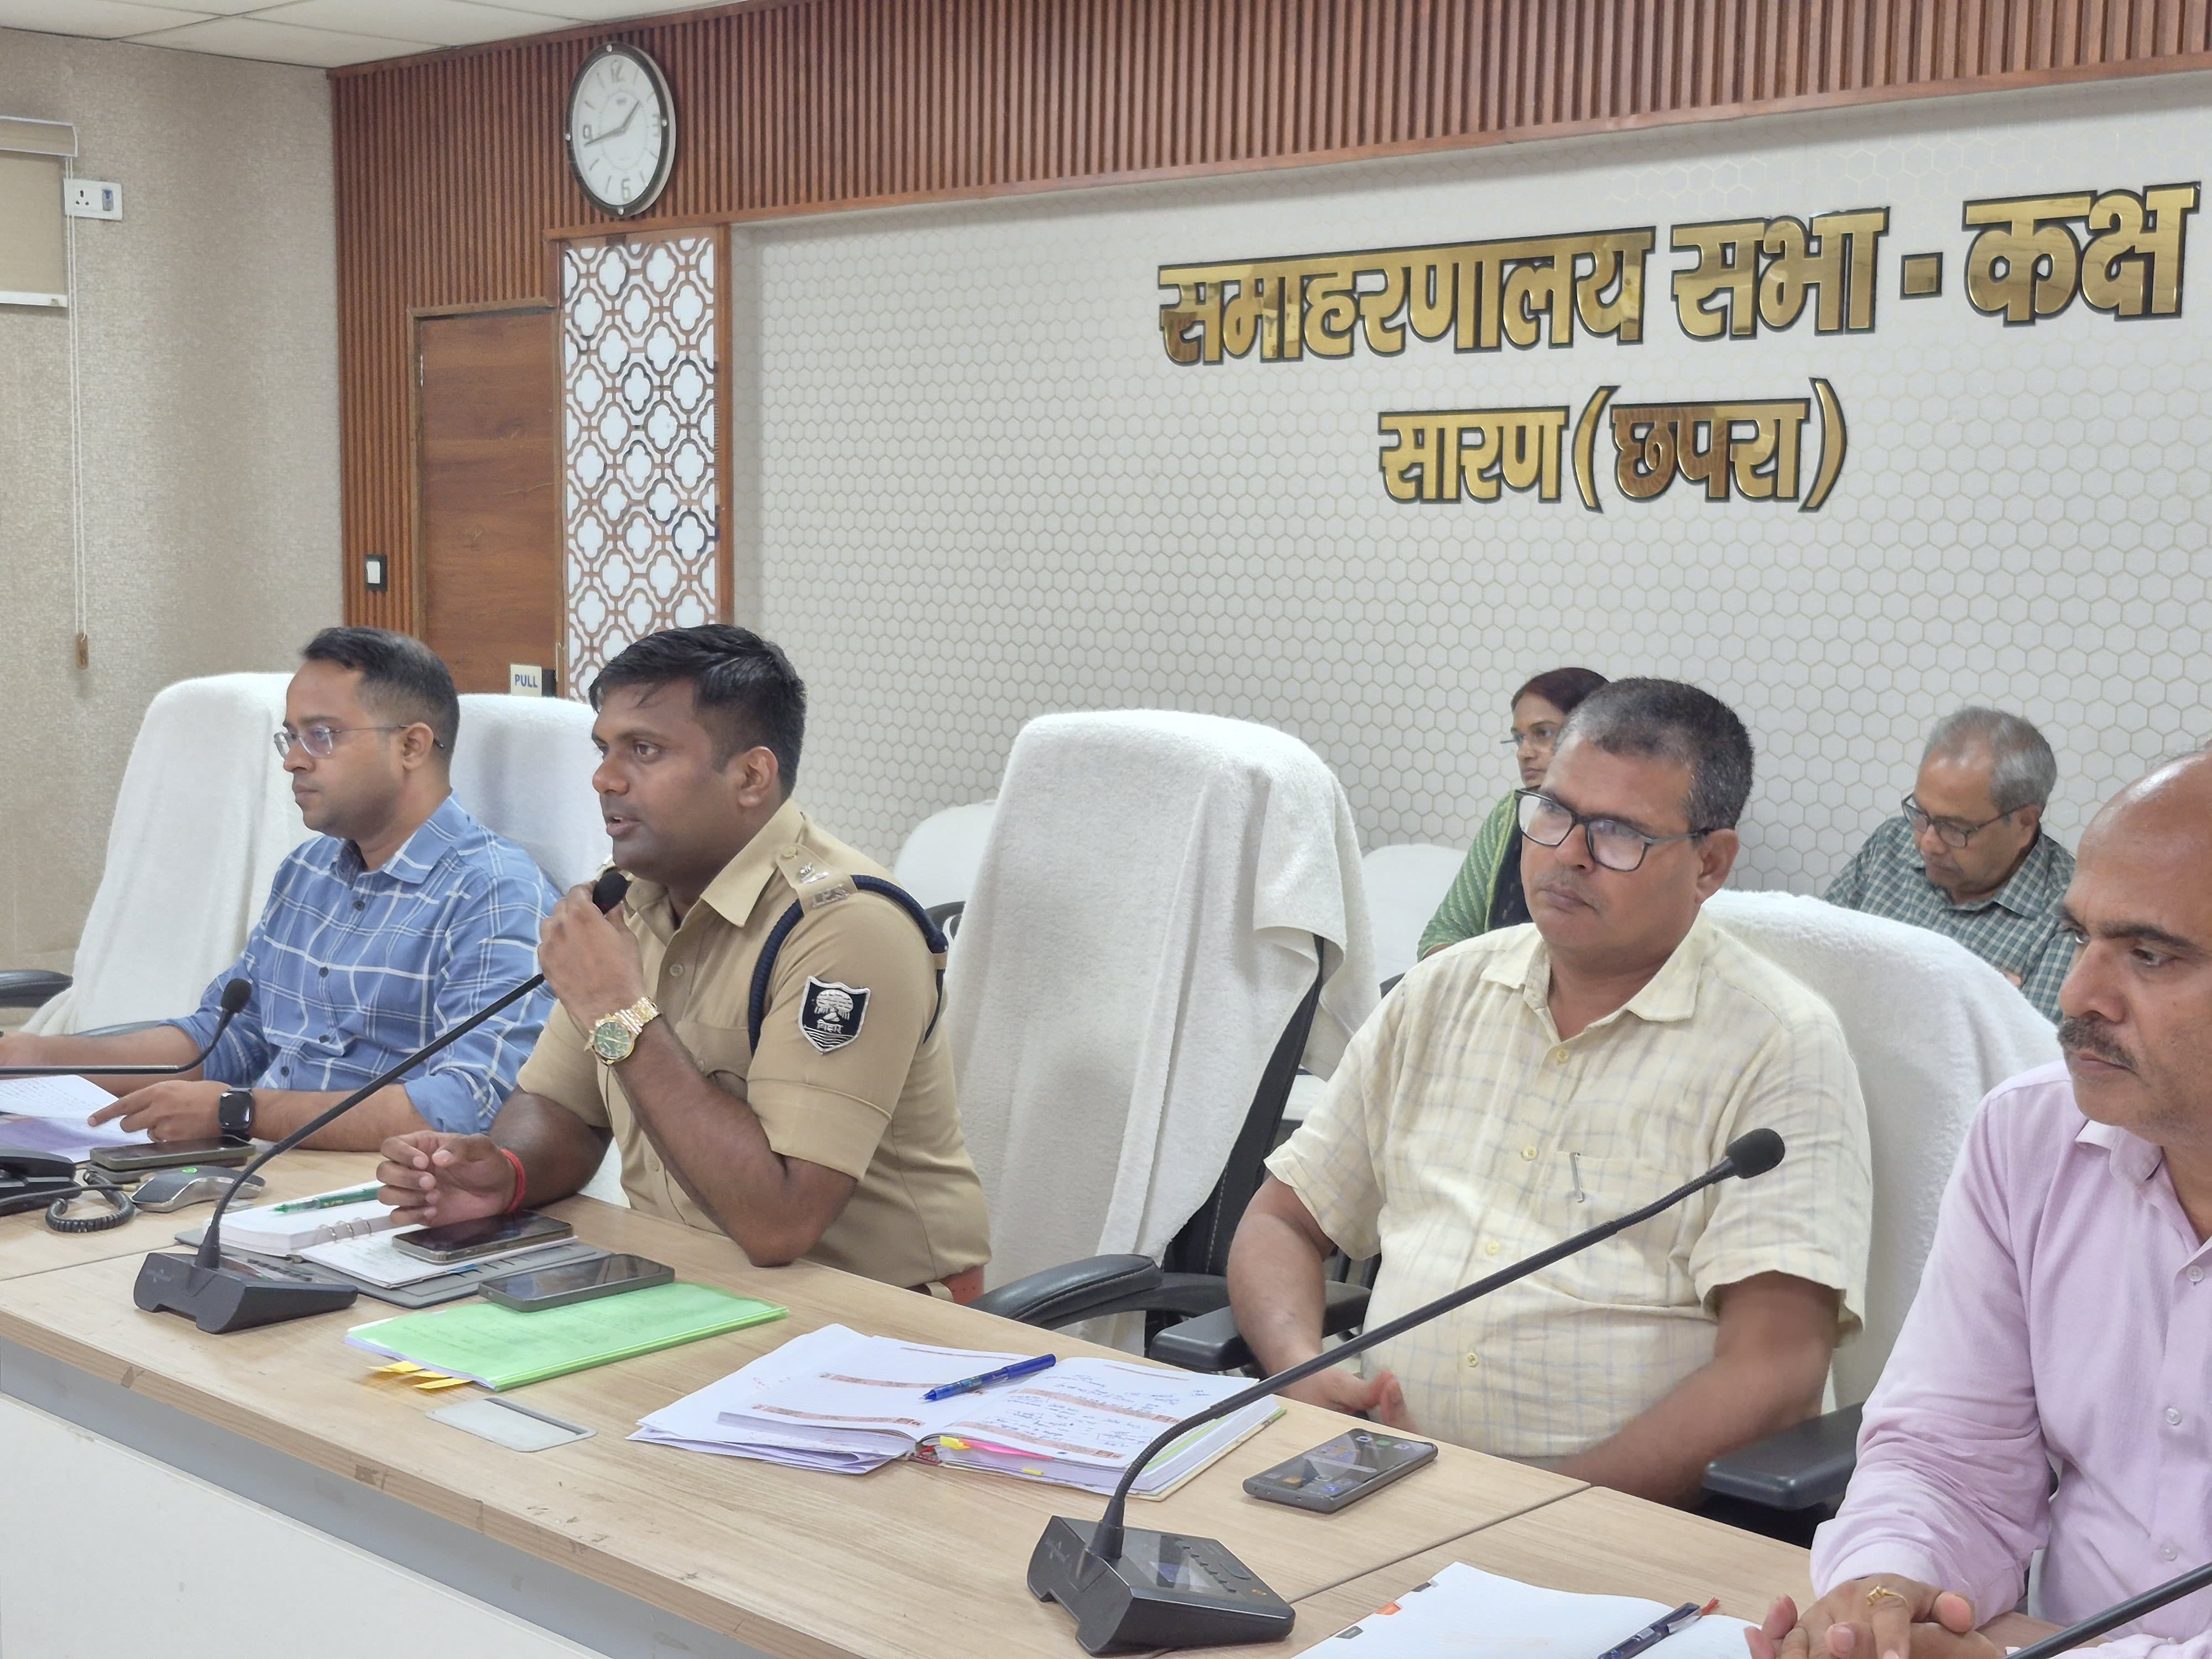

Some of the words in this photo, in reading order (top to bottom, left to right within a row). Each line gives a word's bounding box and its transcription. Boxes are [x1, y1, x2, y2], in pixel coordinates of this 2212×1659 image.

[1158, 226, 1656, 366] समाहरणालय
[1670, 206, 1890, 343] सभा
[514, 674, 538, 688] PULL
[813, 884, 851, 908] IPS
